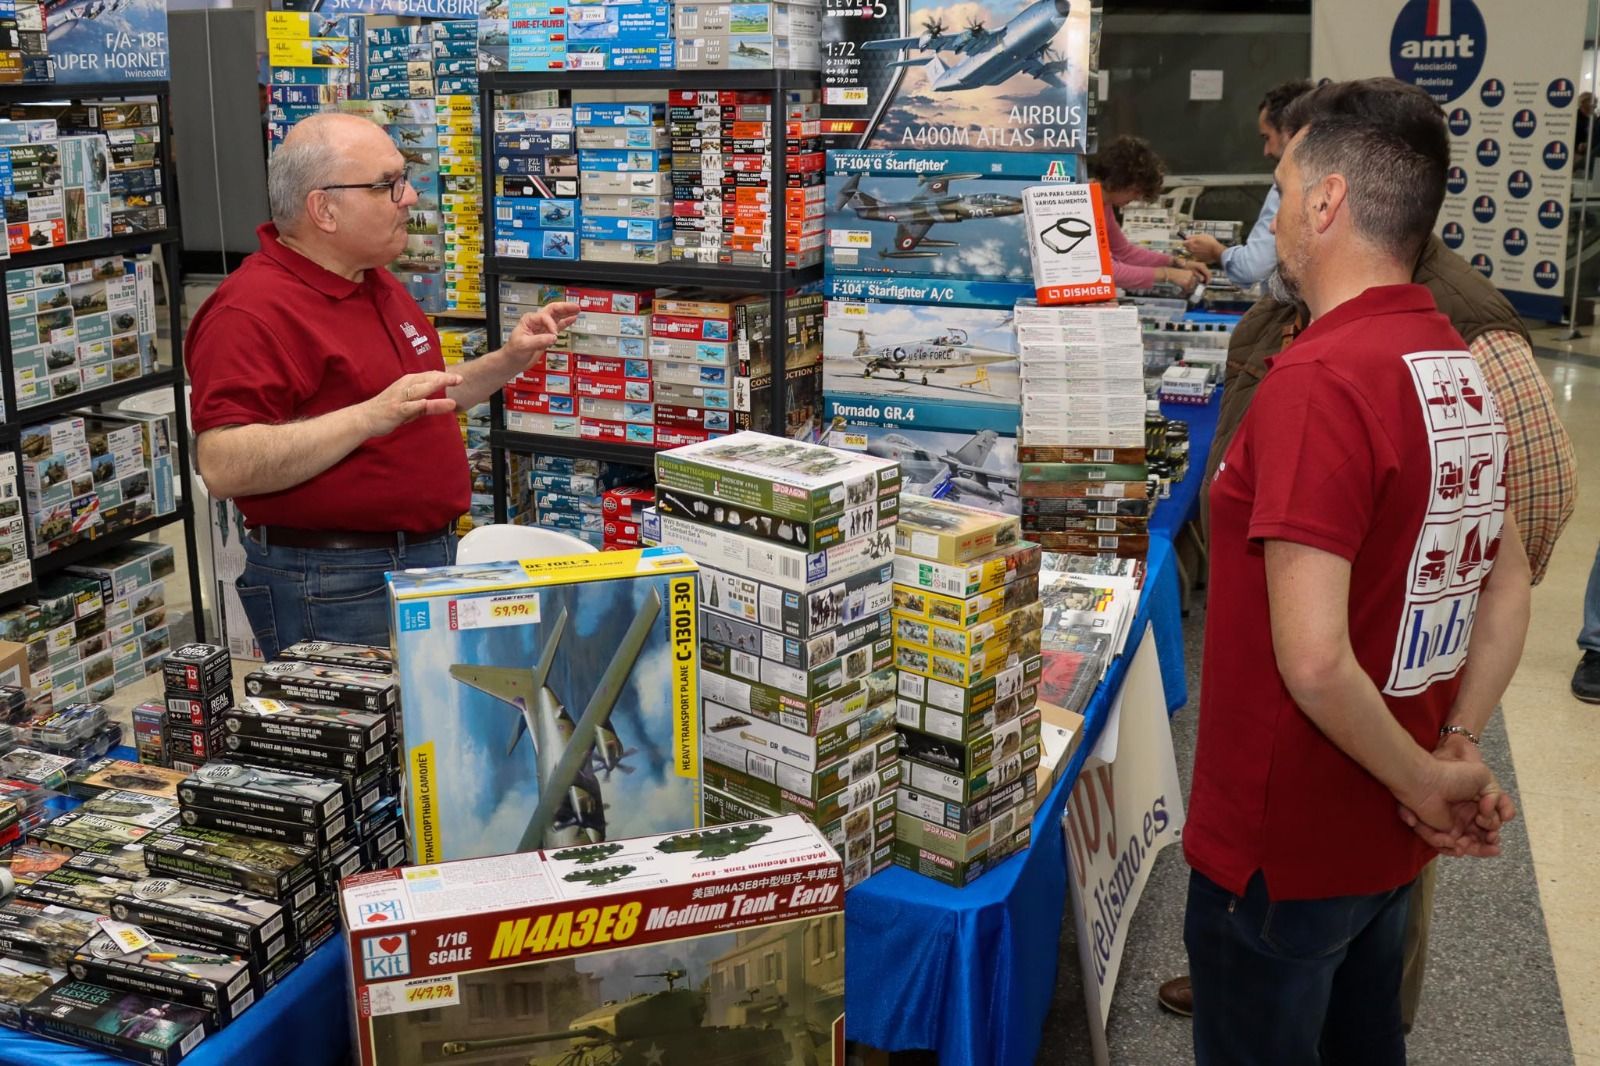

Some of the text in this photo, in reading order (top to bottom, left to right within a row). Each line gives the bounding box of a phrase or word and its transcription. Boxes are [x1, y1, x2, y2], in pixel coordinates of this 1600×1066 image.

[106, 31, 165, 51] F/A-18F
[825, 42, 856, 57] 1:72
[1400, 34, 1475, 58] amt
[48, 52, 167, 71] SUPER HORNET
[844, 58, 861, 66] PARTS
[1413, 61, 1458, 71] Asociación
[124, 68, 167, 78] twinseater
[1415, 77, 1454, 87] Modelista
[1007, 105, 1081, 124] AIRBUS
[830, 121, 854, 132] NEW
[901, 127, 1080, 148] A400M ATLAS RAF
[885, 159, 949, 172] Starfighter
[832, 282, 954, 300] F-104 Starfighter A/C
[1063, 286, 1111, 297] DISMOER
[929, 351, 952, 361] FORCE
[831, 402, 915, 421] Tornado GR.4
[417, 610, 427, 627] 1/72
[674, 581, 692, 662] C-130J-30
[188, 669, 197, 680] 13
[680, 665, 689, 694] PLANE
[191, 704, 200, 715] 9
[210, 693, 228, 708] REAL
[681, 694, 690, 744] TRANSPORT
[193, 734, 202, 747] 8
[769, 741, 779, 750] OR
[682, 745, 691, 770] HEAVY
[206, 770, 230, 778] WAR
[417, 752, 430, 795] САМОЛЁТ
[725, 800, 763, 821] INFANTR
[420, 795, 435, 864] ТРАНСПОРТНЫЙ
[142, 884, 167, 894] WAR
[151, 879, 169, 887] AIR
[692, 867, 839, 900] 美国M4A3E8中型坦克-早期型
[1091, 794, 1170, 986] delismo.es
[645, 901, 728, 932] Medium
[730, 890, 775, 918] Tank
[789, 882, 840, 908] Early
[436, 931, 468, 948] 1/16
[489, 901, 642, 961] M4A3E8
[368, 938, 373, 957] I
[428, 946, 473, 965] SCALE
[371, 956, 403, 977] Kit
[56, 987, 90, 1001] FLESH
[90, 994, 111, 1005] SET
[66, 981, 115, 998] MALEFIC
